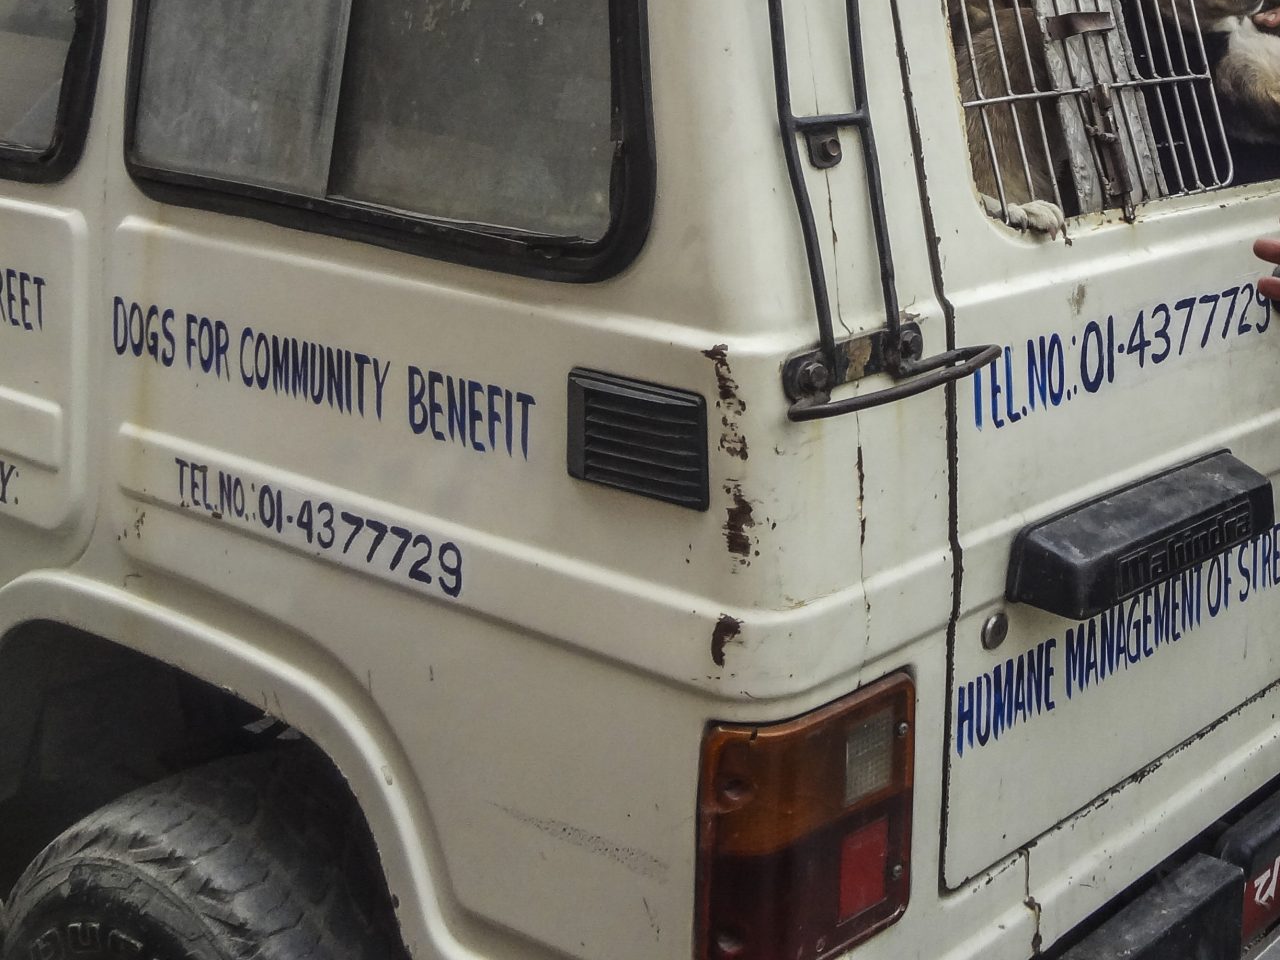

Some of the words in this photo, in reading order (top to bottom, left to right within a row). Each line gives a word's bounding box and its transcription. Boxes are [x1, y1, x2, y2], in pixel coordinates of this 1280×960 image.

[113, 295, 175, 368] DOGS
[186, 313, 231, 382] FOR
[239, 326, 391, 420] COMMUNITY
[407, 365, 536, 461] BENEFIT
[957, 638, 1056, 758] HUMANE
[1065, 565, 1203, 700] MANAGEMENT
[1207, 550, 1233, 617] OF
